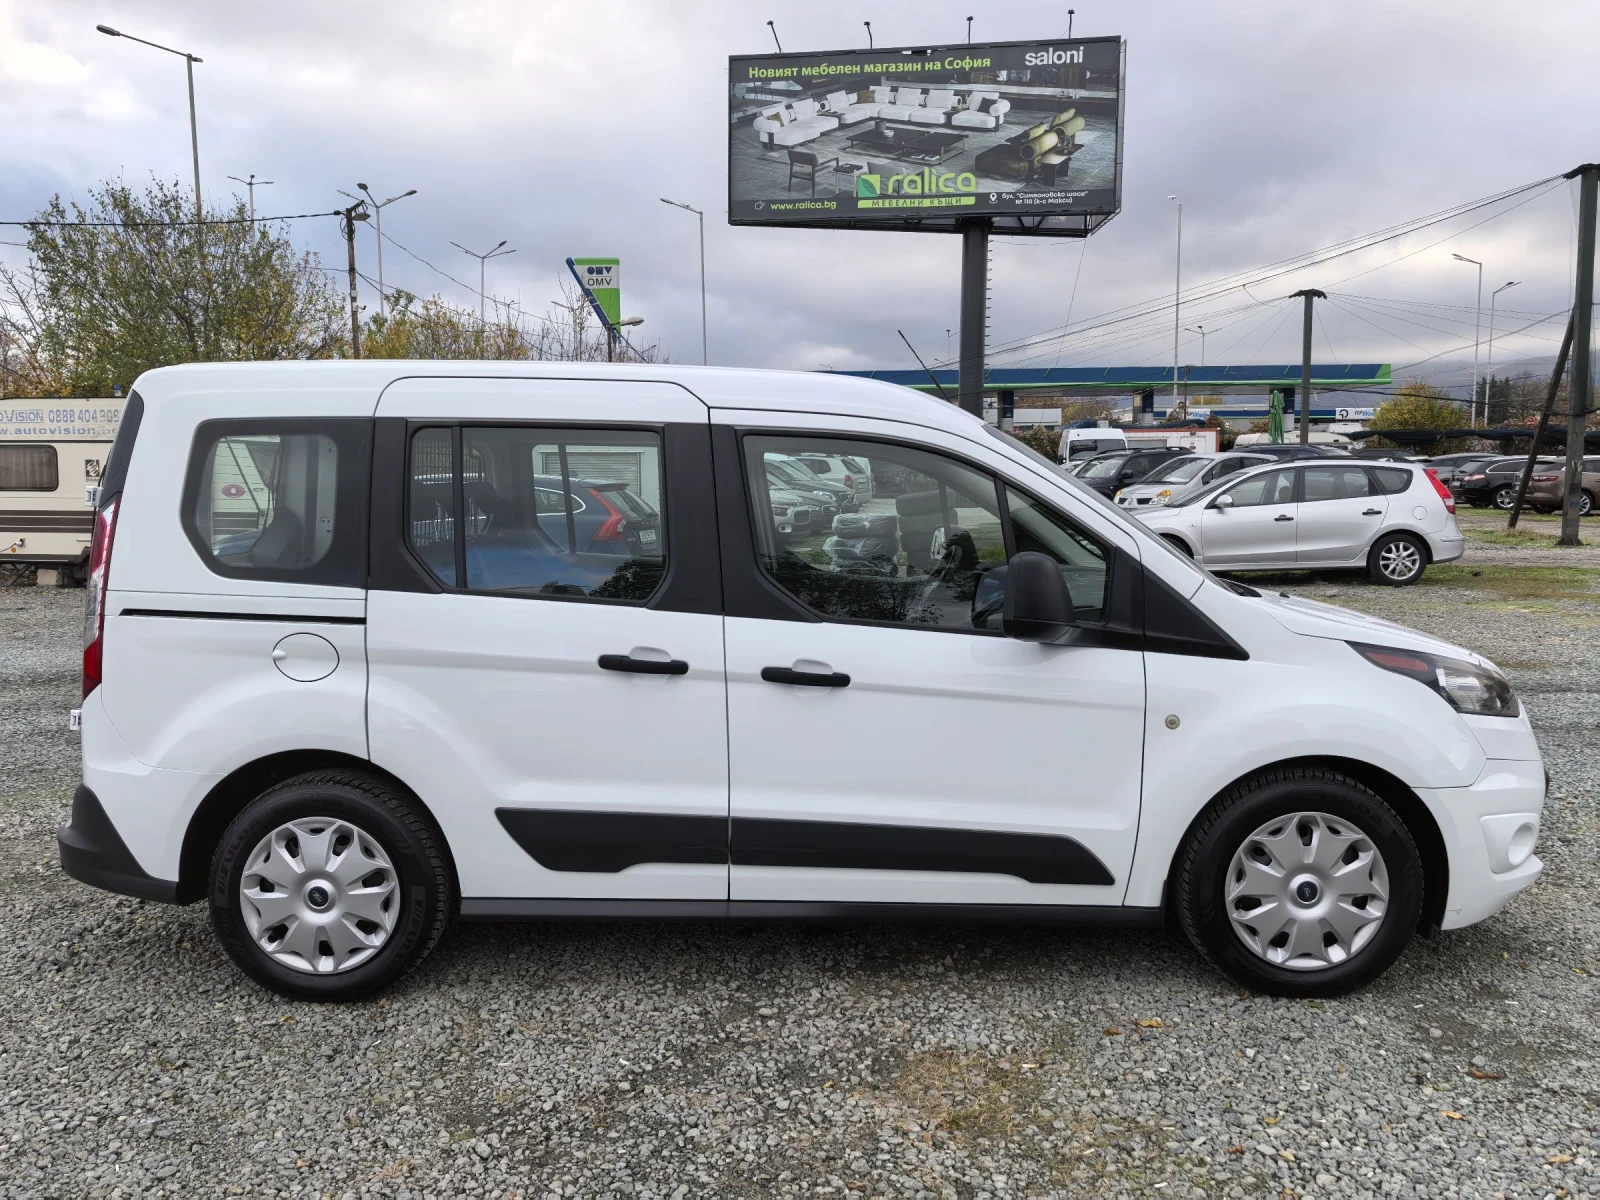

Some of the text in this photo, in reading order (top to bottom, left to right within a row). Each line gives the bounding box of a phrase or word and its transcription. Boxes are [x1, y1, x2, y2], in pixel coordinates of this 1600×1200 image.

[1025, 46, 1084, 66] saloni
[748, 57, 991, 79] Новият мебелен магазин на София
[888, 166, 977, 195] ralica
[770, 200, 837, 211] www.ralica.bg
[871, 197, 962, 208] МЕБЕЛНИ КЪЩИ
[587, 278, 612, 287] OMV
[48, 409, 76, 424] 0888
[78, 409, 98, 424] 404
